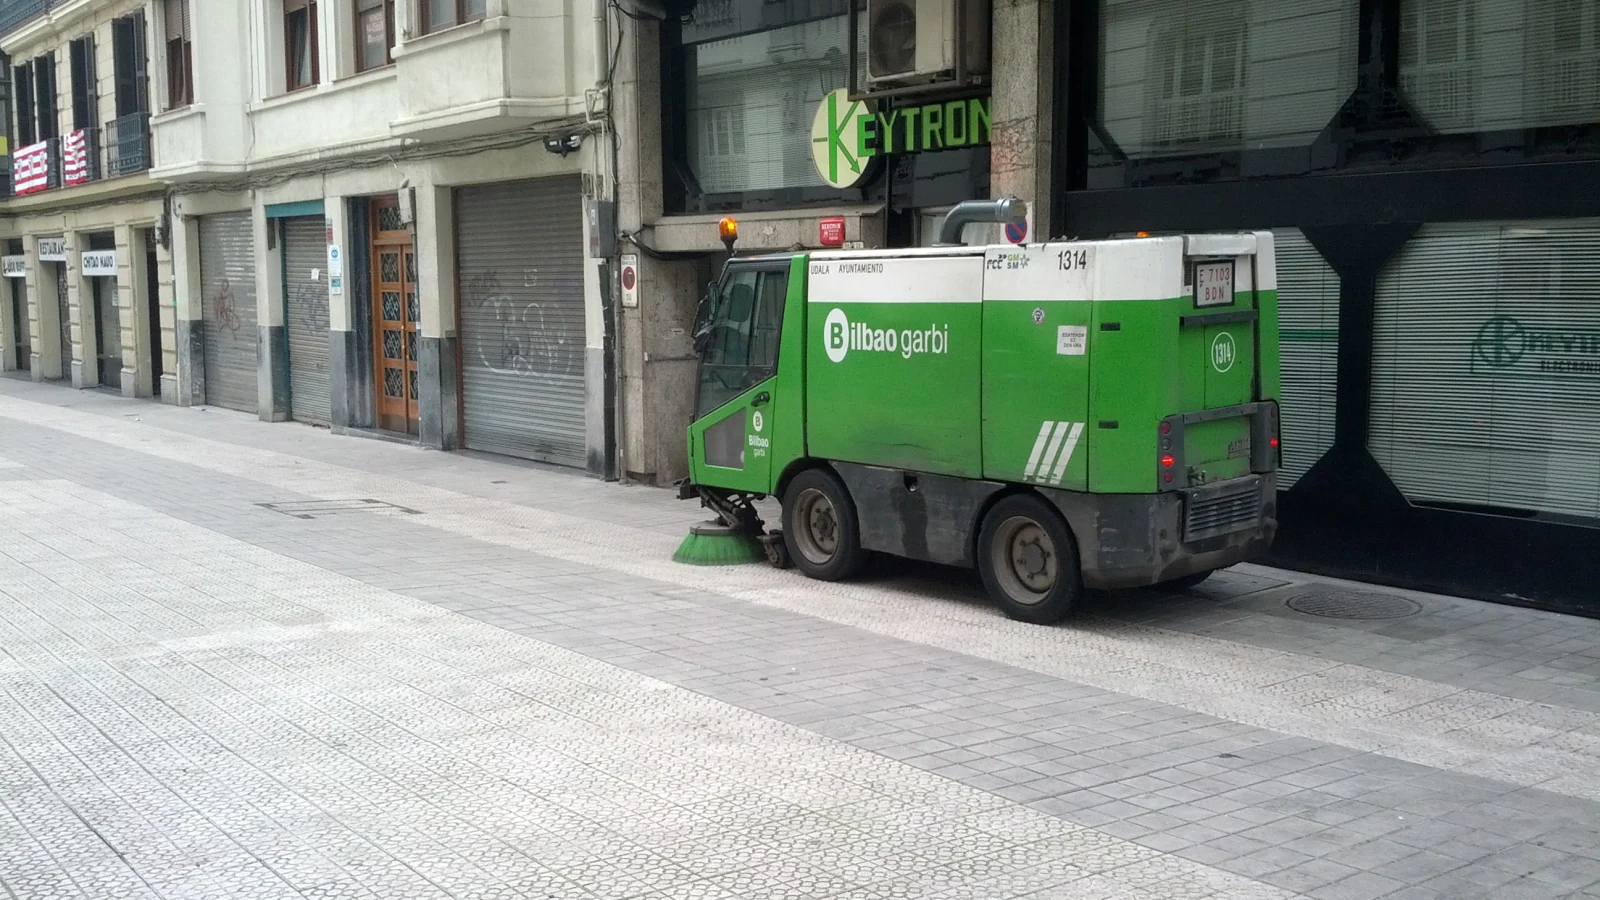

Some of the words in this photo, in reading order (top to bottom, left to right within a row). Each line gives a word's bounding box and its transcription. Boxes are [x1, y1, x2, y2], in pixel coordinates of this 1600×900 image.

[826, 91, 992, 184] KEYTRON
[1007, 261, 1019, 269] SM
[1058, 249, 1087, 271] 1314
[810, 264, 830, 275] UDALA
[838, 263, 884, 274] AYUNTAMIENTO
[1208, 267, 1231, 282] 7103
[828, 320, 898, 353] Bilbao
[900, 323, 948, 359] garbi
[1214, 341, 1232, 365] 1314
[1540, 359, 1600, 373] ELECTRONI
[748, 435, 769, 447] Bilbao
